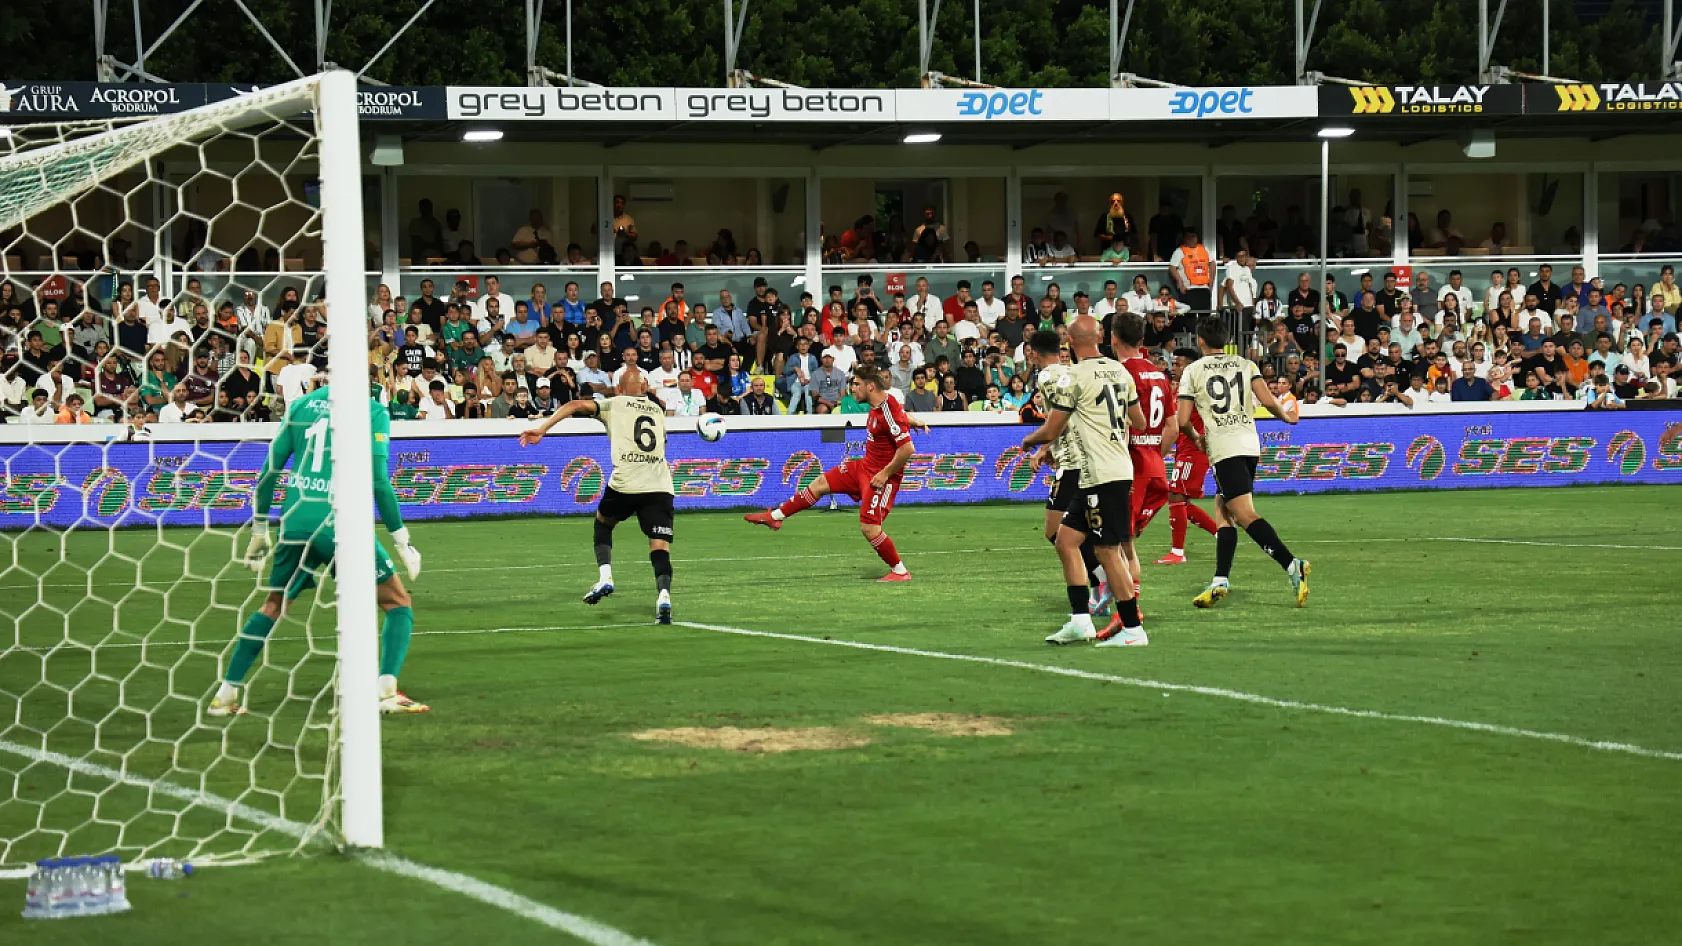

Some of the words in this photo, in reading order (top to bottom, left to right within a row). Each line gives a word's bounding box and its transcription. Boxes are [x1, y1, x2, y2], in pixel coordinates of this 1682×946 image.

[31, 85, 62, 95] GRUP
[89, 87, 180, 104] ACROPOL
[356, 90, 422, 107] CROPOL
[1395, 86, 1490, 103] TALAY
[17, 95, 80, 112] AURA
[112, 103, 158, 113] BODRUM
[359, 106, 403, 116] BODRUM
[458, 93, 546, 117] grey
[558, 88, 662, 112] beton
[687, 93, 770, 117] grey
[782, 89, 882, 113] beton
[957, 88, 1043, 119] opet
[1168, 88, 1253, 118] opet
[1401, 105, 1483, 113] LOGISTICS
[1206, 371, 1245, 414] 91
[1096, 383, 1128, 429] 15
[1149, 385, 1165, 428] 6
[304, 417, 329, 472] 1
[633, 415, 656, 453] 6
[1453, 437, 1598, 476] SES
[870, 495, 879, 508] 9
[1085, 508, 1103, 529] 15
